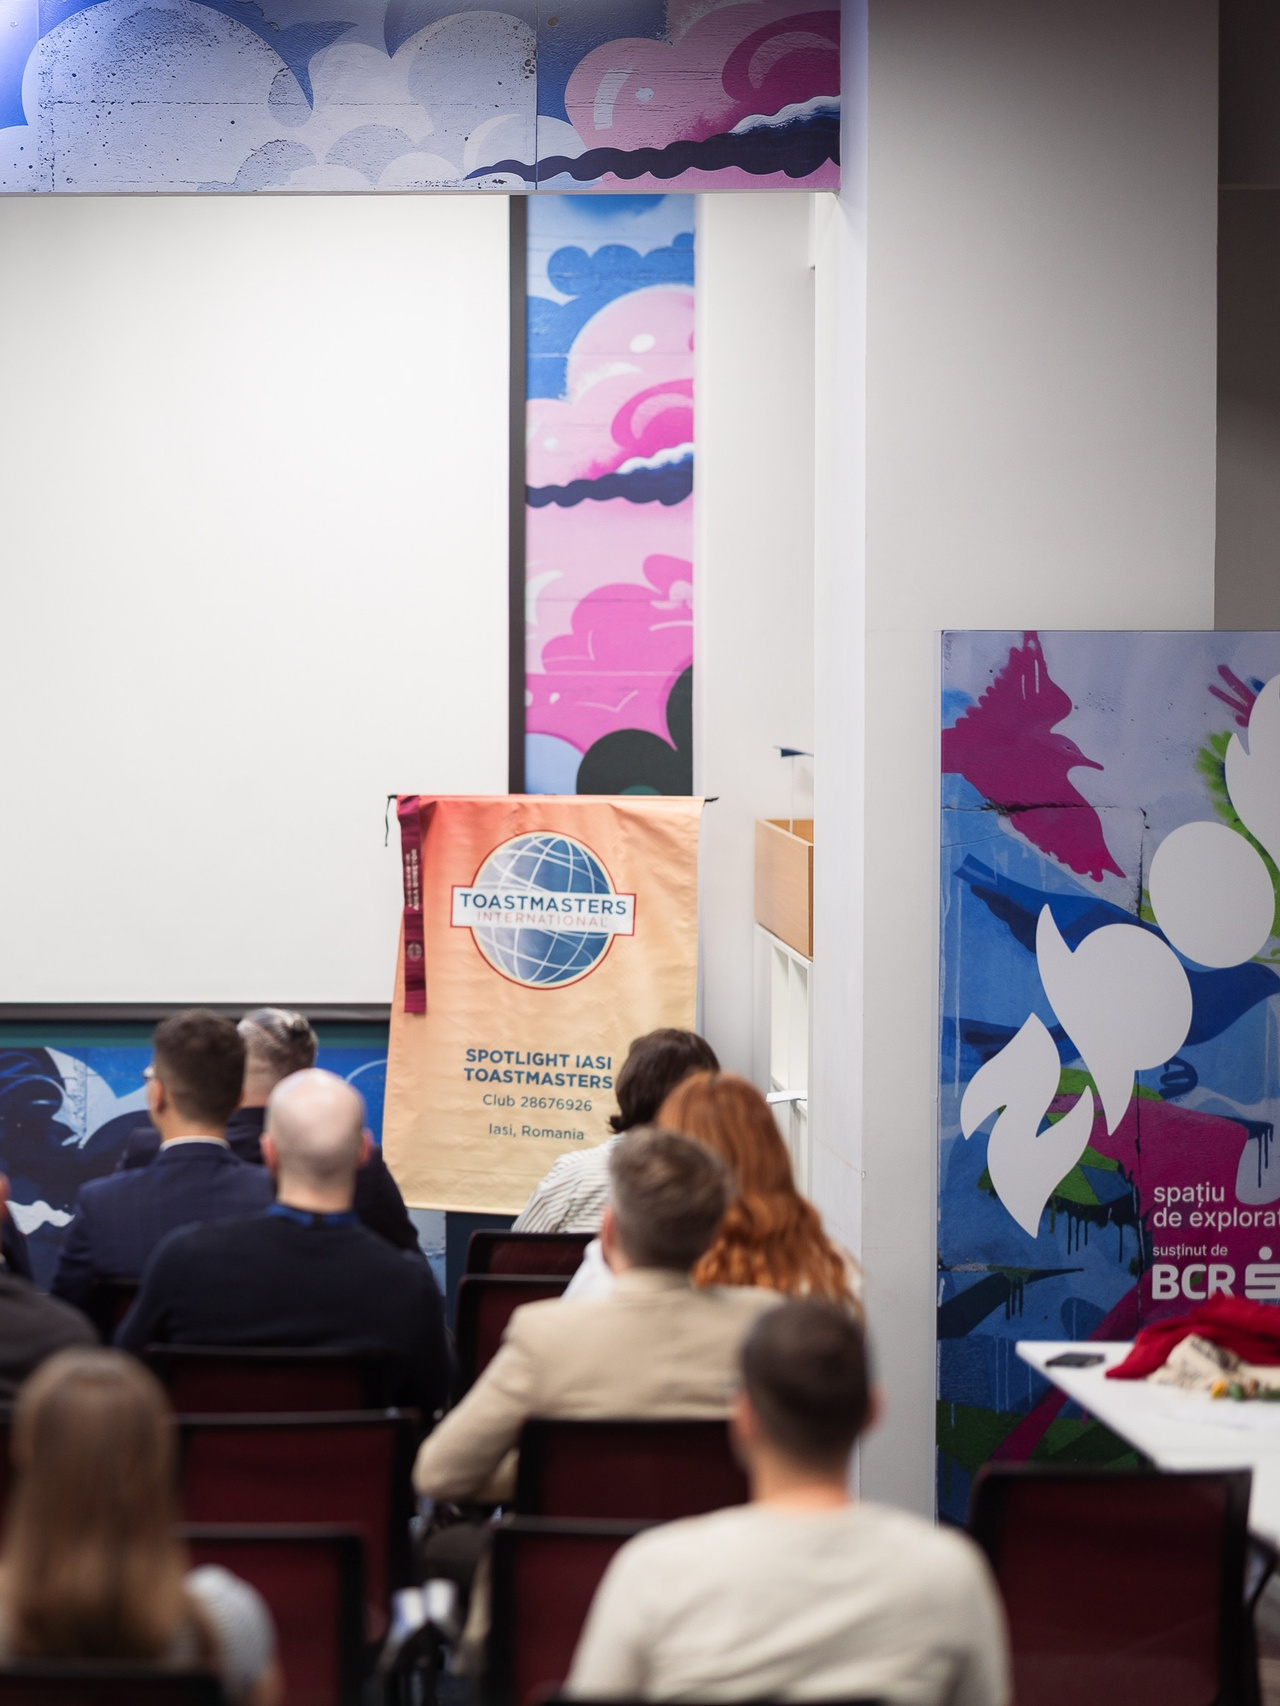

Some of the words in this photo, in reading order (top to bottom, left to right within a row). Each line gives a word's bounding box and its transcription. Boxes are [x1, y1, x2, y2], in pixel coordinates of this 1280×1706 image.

[460, 893, 627, 915] TOASTMASTERS
[477, 911, 608, 928] INTERNATIONAL
[466, 1048, 570, 1068] SPOTLIGHT
[575, 1055, 612, 1070] IASI
[464, 1067, 613, 1089] TOASTMASTERS
[483, 1094, 516, 1107] Club
[520, 1096, 593, 1111] 28676926
[489, 1123, 517, 1138] Iasi,
[521, 1125, 585, 1140] Romania
[1153, 1181, 1225, 1208] spațiu
[1153, 1207, 1182, 1227] de
[1152, 1244, 1207, 1260] susținut
[1210, 1244, 1228, 1256] de
[1152, 1264, 1236, 1300] BCR
